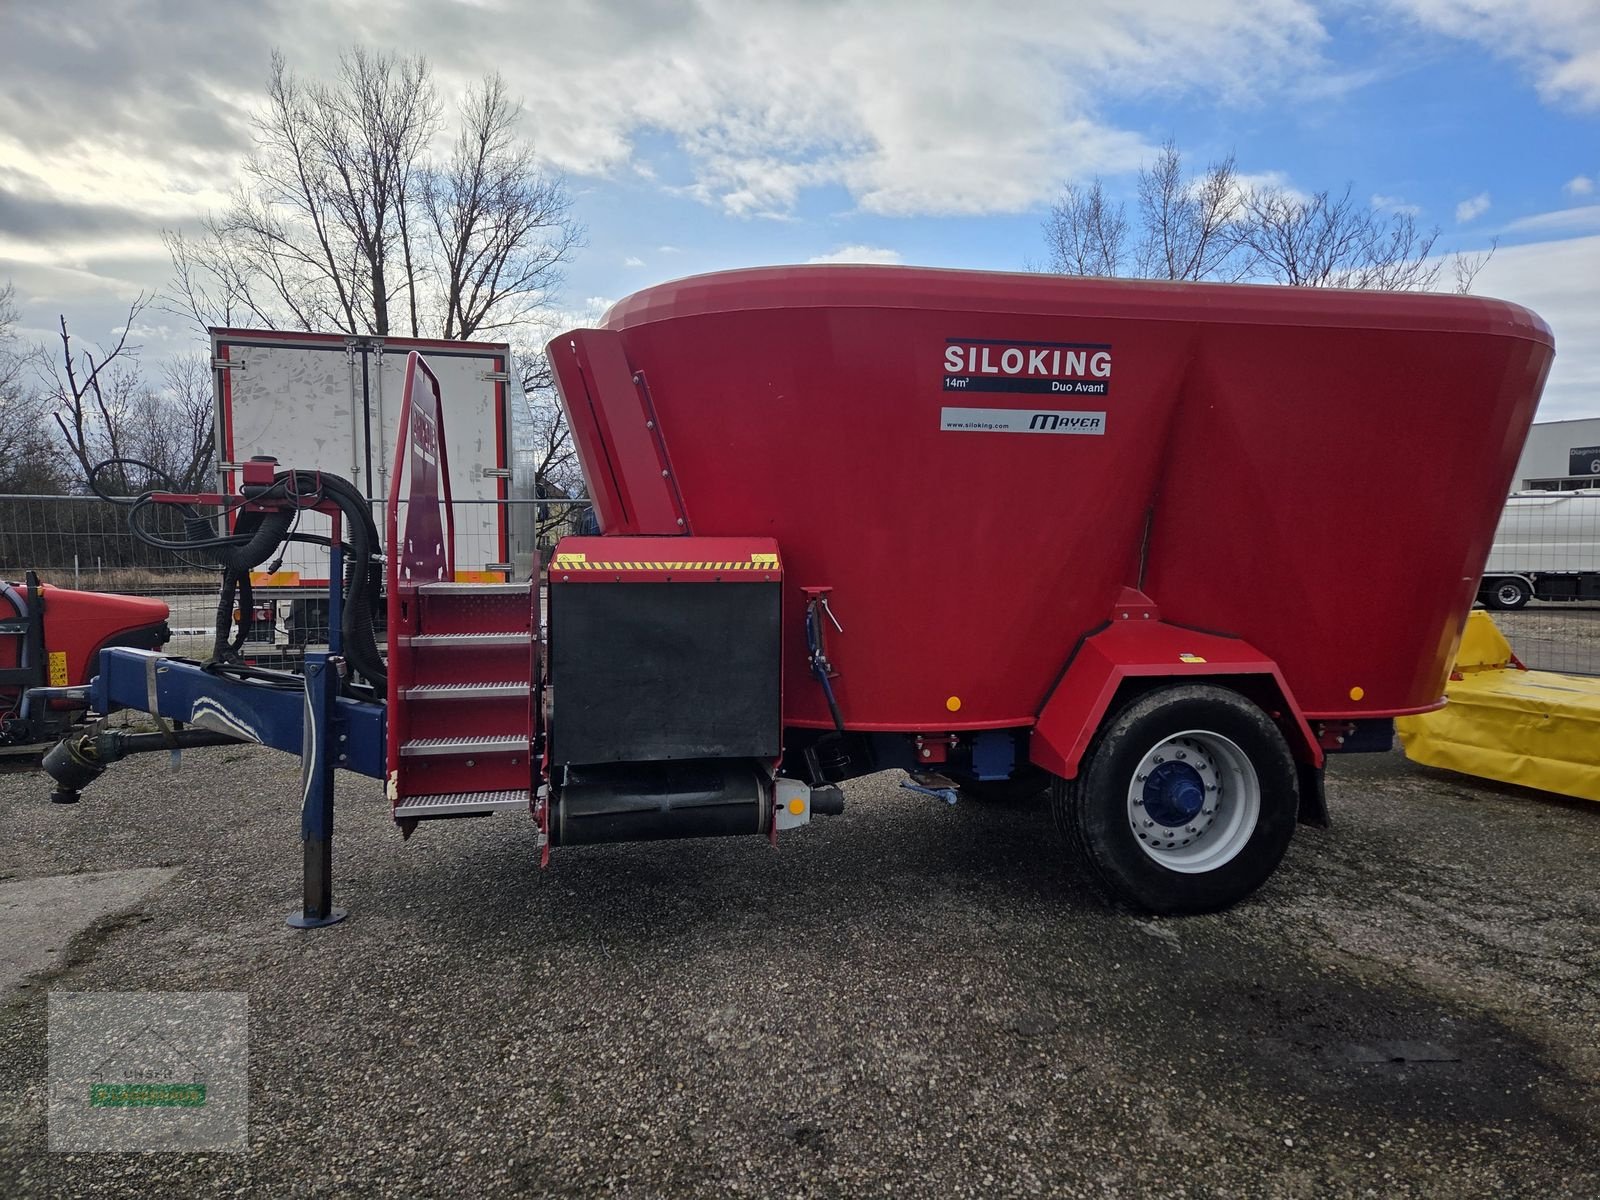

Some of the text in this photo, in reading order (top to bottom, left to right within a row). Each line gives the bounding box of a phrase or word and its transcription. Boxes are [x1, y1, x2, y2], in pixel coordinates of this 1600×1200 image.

[944, 345, 1112, 378] SILOKING
[1052, 381, 1104, 393] Duo Avant
[946, 422, 1009, 430] www.siloking.com
[1029, 414, 1100, 430] MAYER
